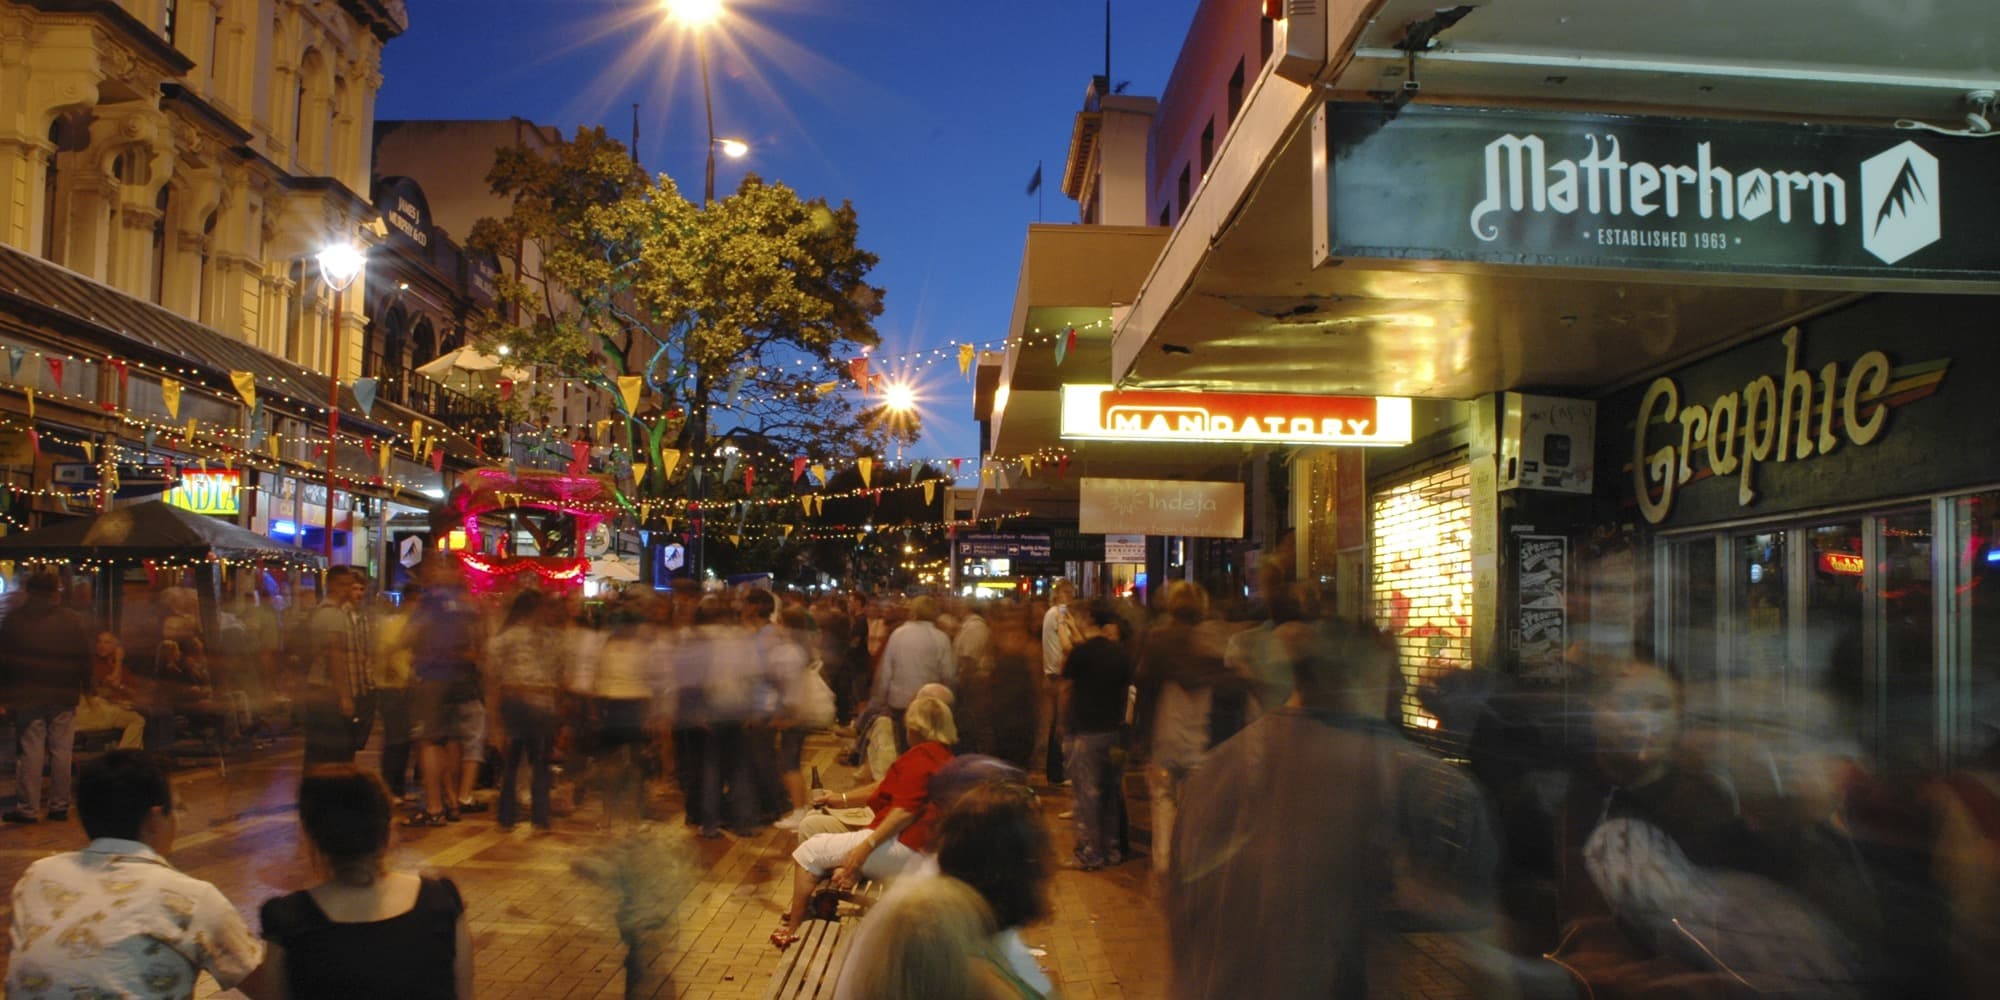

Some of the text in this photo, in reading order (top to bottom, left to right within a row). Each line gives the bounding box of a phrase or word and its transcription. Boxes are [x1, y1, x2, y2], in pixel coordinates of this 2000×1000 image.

[1471, 133, 1845, 241] Matterhorn
[1598, 228, 1727, 250] ESTABLISHED 1963
[1113, 413, 1371, 436] MANDATORY
[1634, 326, 1890, 524] Graphic
